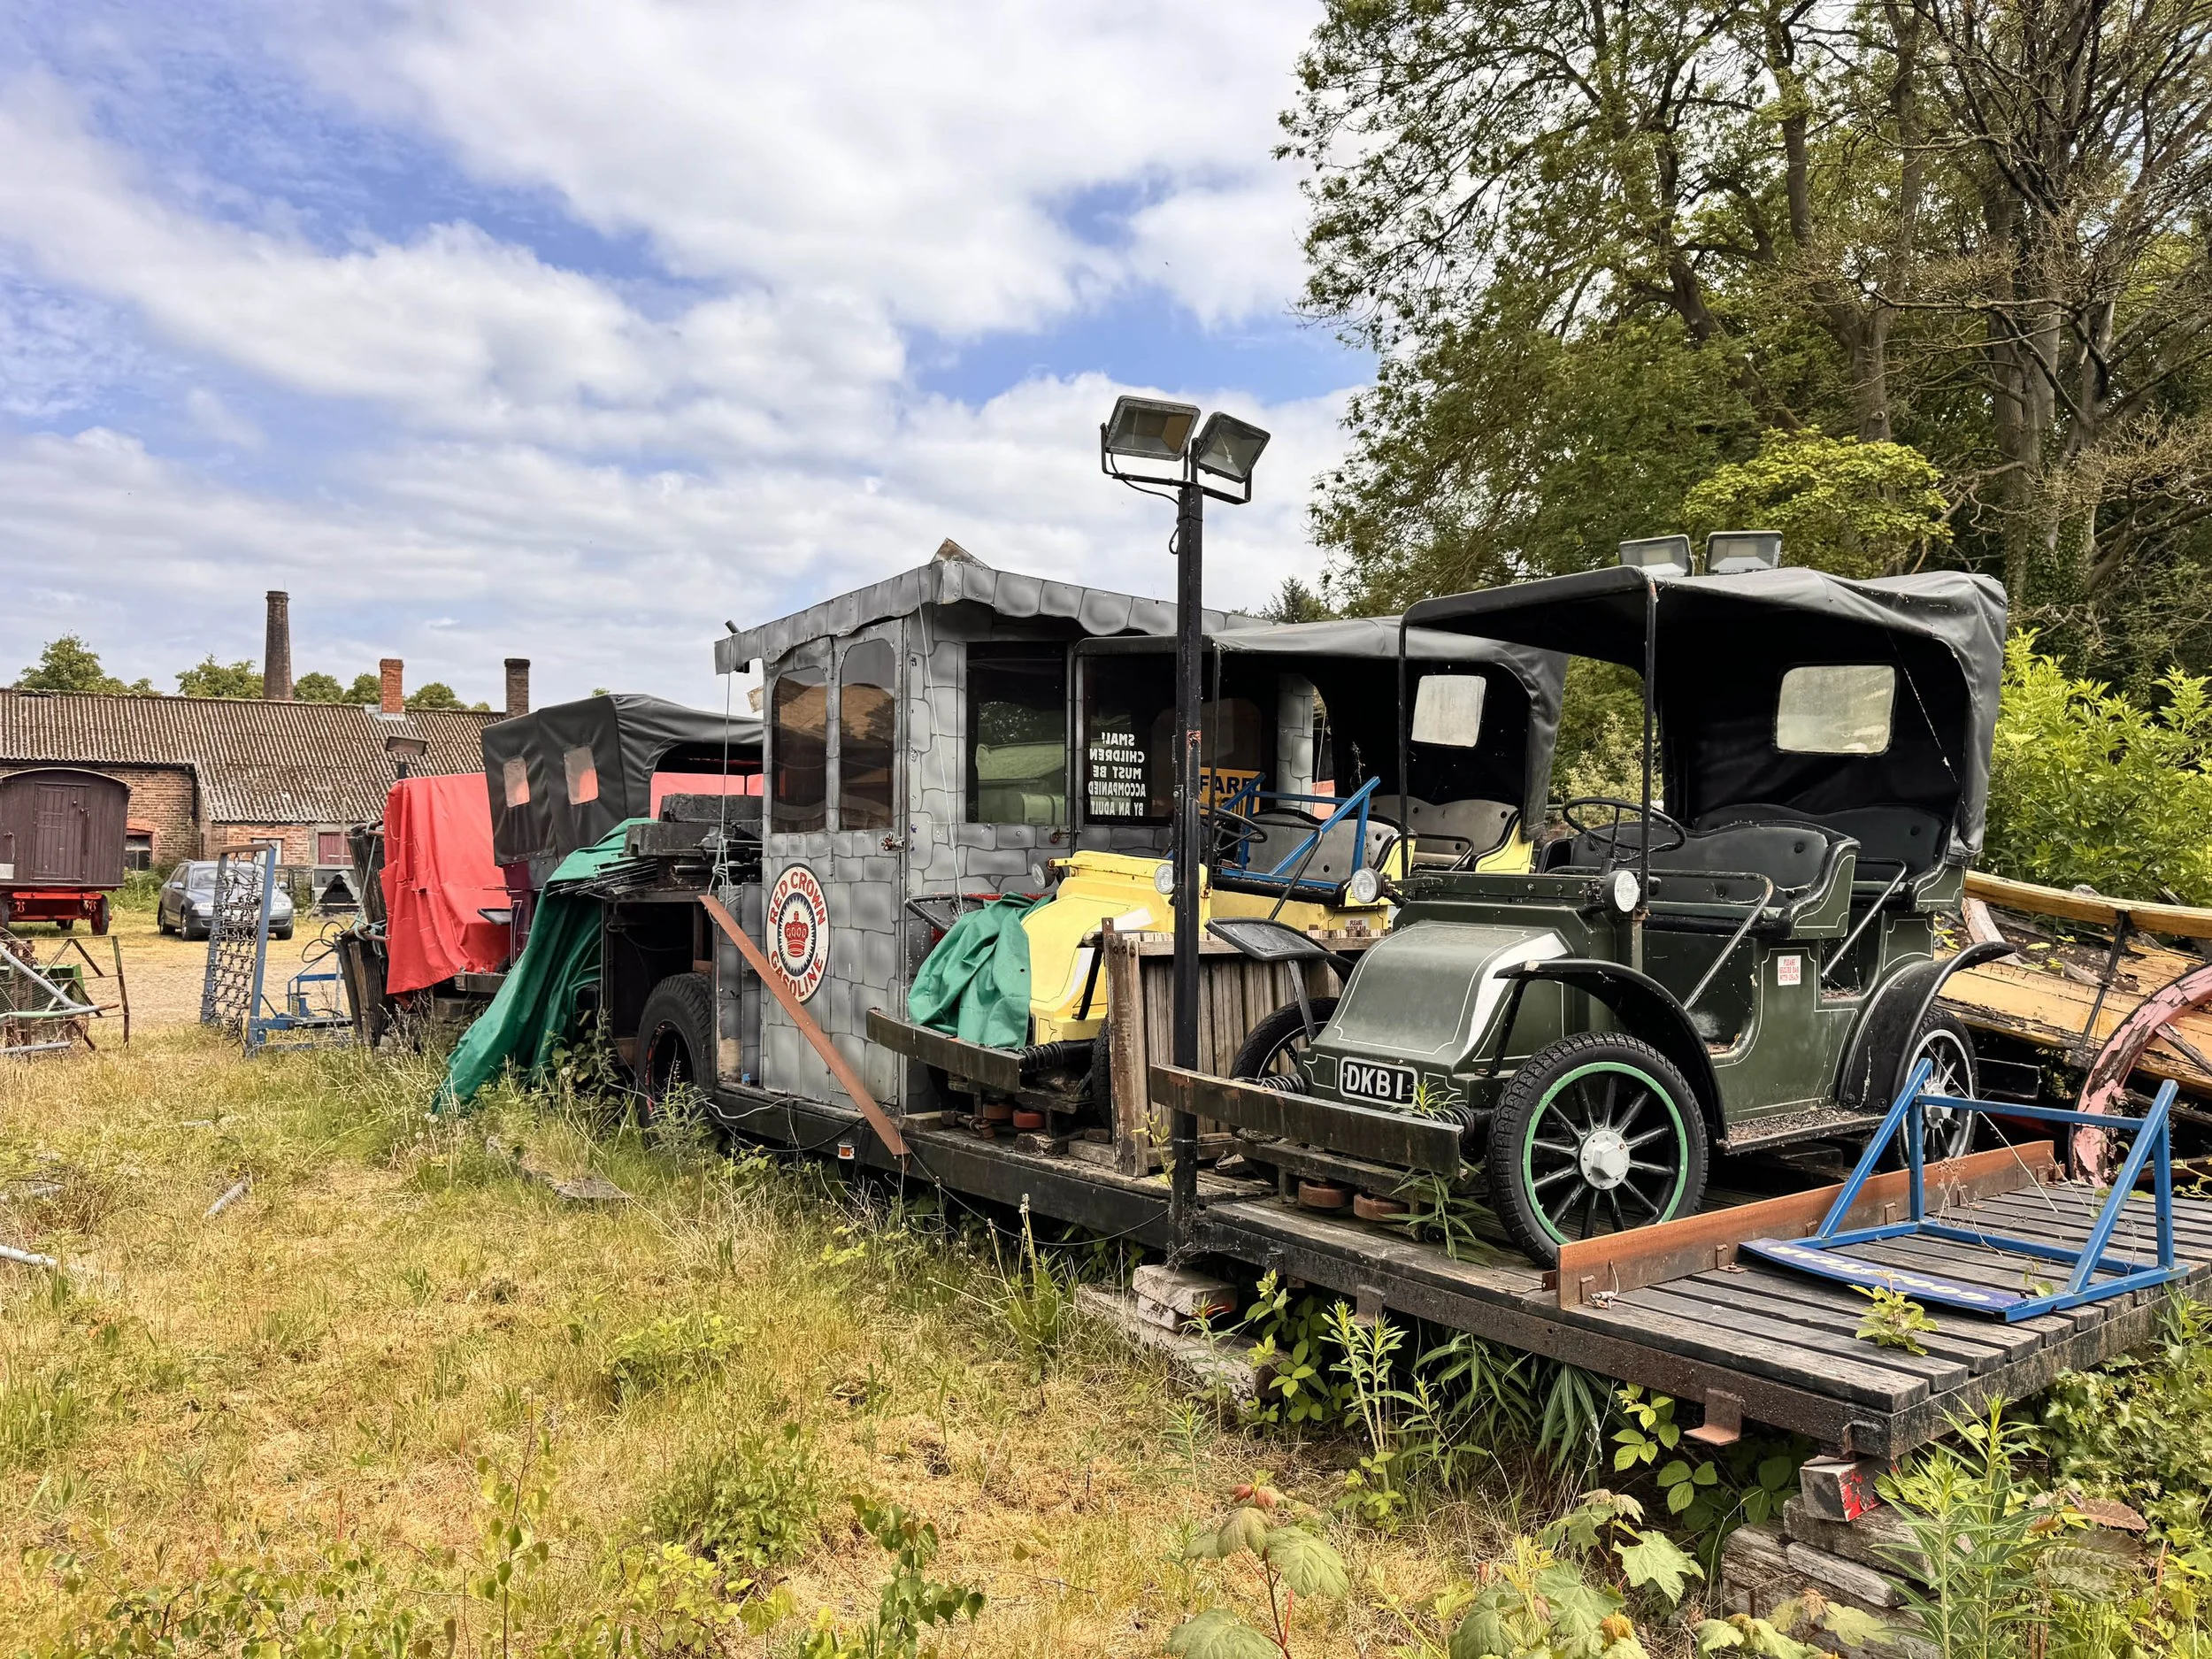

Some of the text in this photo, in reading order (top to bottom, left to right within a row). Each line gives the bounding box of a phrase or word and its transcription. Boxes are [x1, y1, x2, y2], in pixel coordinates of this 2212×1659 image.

[769, 872, 826, 926] RED CROWN
[771, 950, 824, 997] GASOLINE
